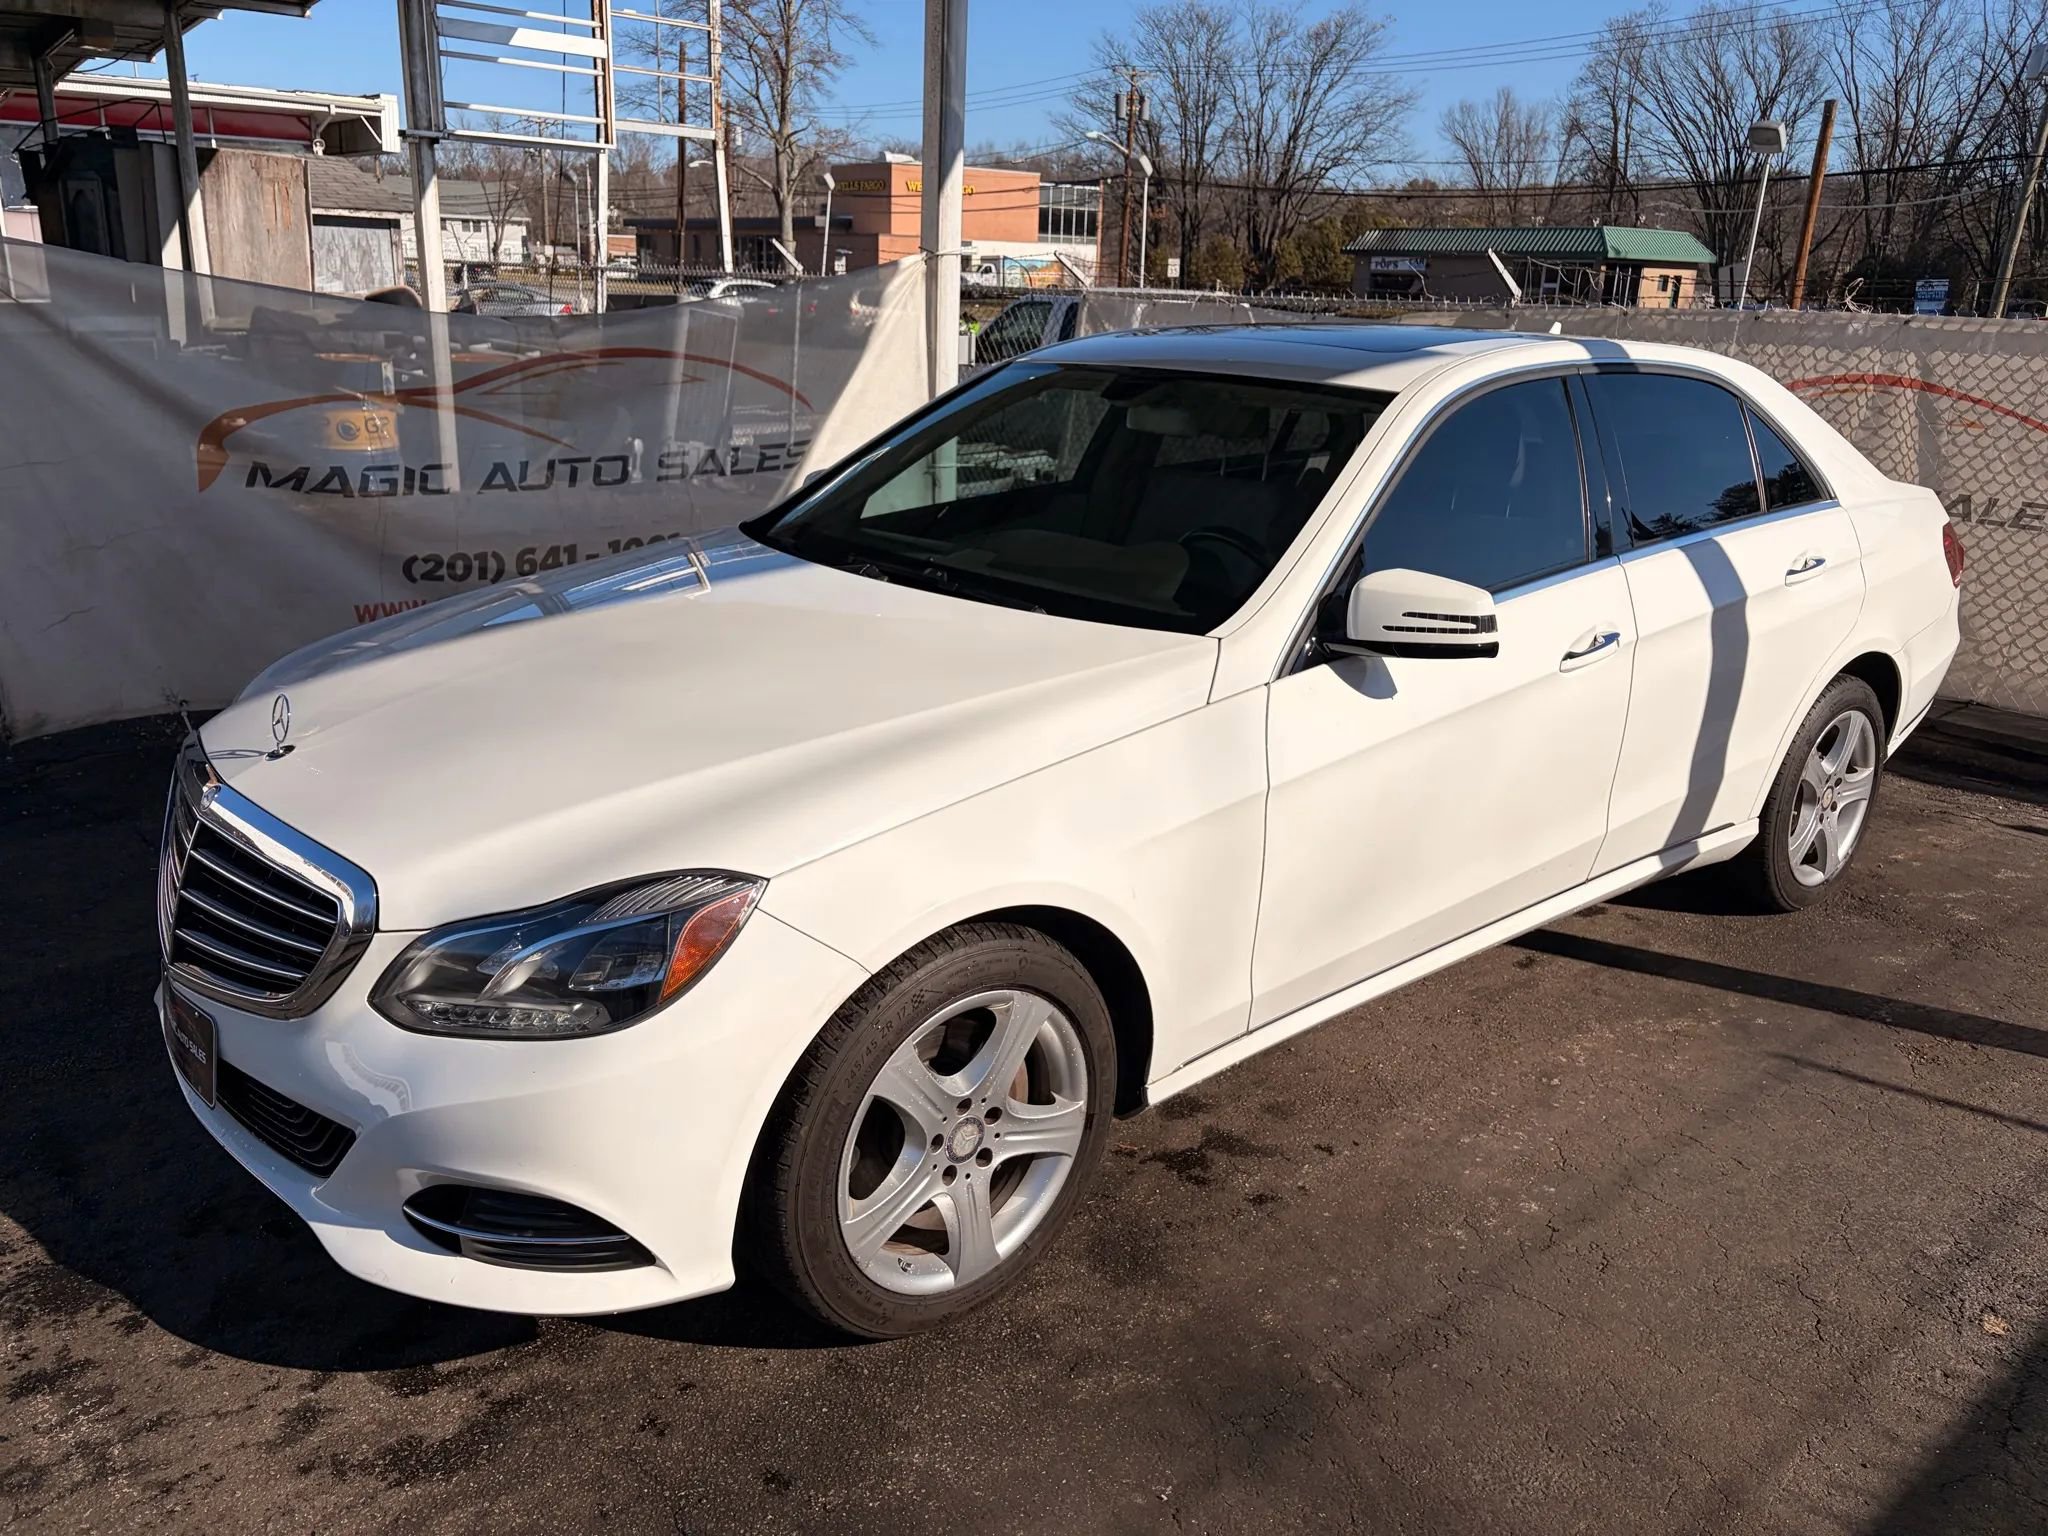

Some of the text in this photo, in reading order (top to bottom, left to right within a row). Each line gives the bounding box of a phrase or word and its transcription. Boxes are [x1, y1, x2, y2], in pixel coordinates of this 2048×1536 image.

[245, 439, 812, 498] MAGIC AUTO SALES
[402, 550, 506, 585] (201)
[515, 543, 578, 578] 641
